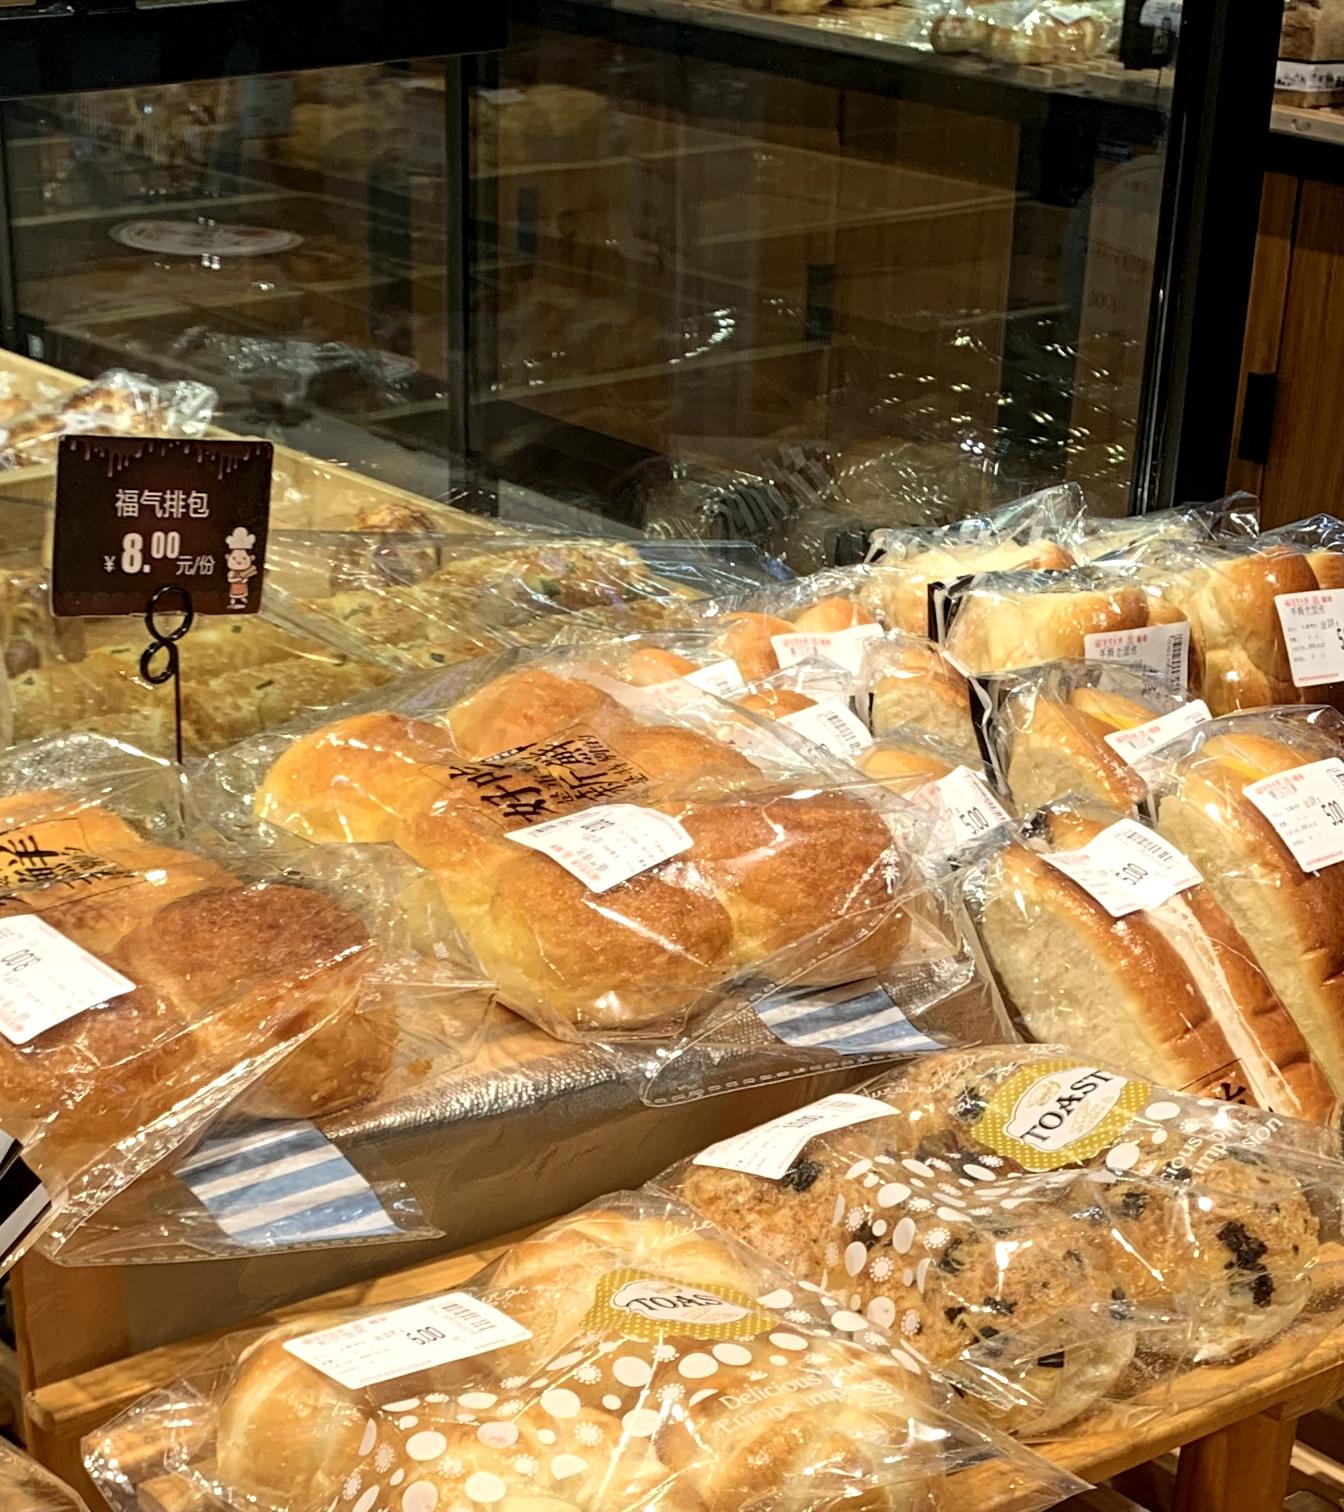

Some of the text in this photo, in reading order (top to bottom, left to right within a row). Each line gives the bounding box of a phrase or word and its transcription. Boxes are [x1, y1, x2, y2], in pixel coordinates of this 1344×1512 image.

[115, 489, 210, 518] 福气排包
[121, 531, 181, 574] 8.00
[176, 555, 216, 576] 元/份
[1114, 862, 1149, 886] 5.00
[1020, 1070, 1114, 1141] TOAST
[627, 1293, 724, 1312] TOAS
[719, 1377, 824, 1411] Delicious
[716, 1403, 801, 1435] Europe
